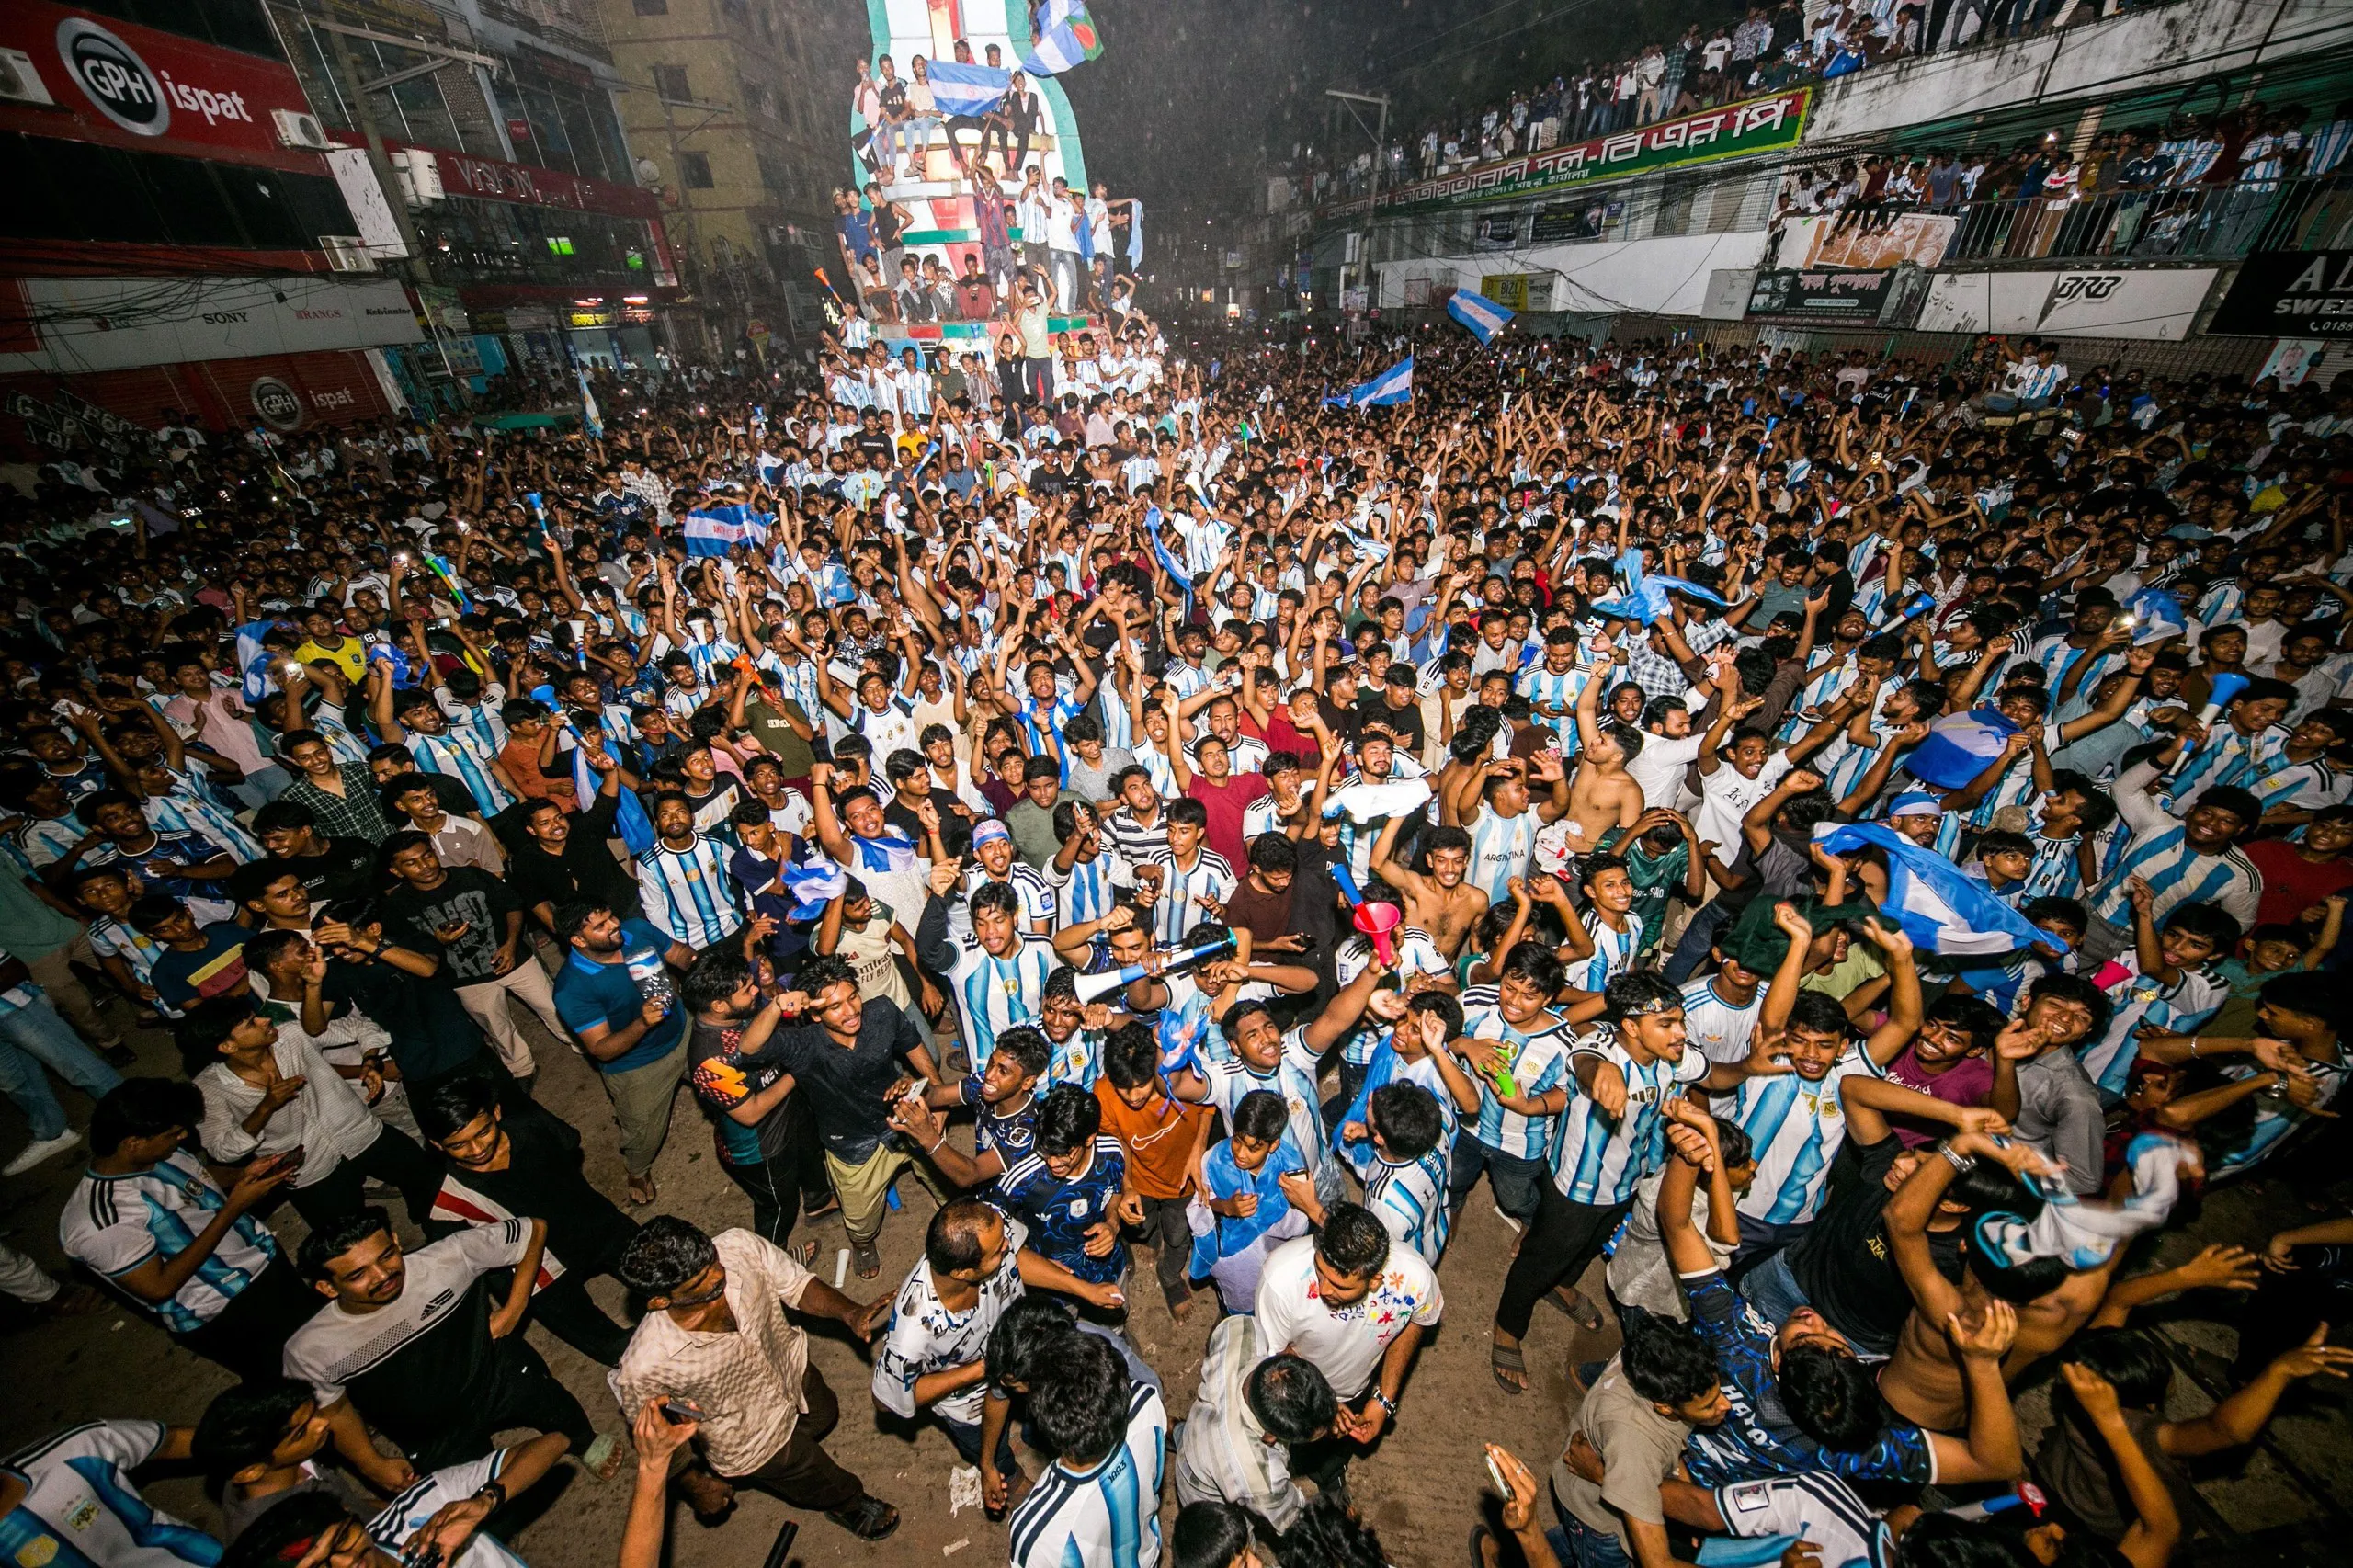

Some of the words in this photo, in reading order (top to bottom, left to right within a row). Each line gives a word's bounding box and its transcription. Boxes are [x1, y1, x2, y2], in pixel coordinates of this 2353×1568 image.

[83, 58, 153, 104] GPH
[160, 70, 254, 126] ispat
[449, 157, 537, 198] VISION
[1327, 190, 1389, 221] বাংলাশ
[2058, 275, 2122, 299] BRB
[202, 312, 249, 324] SONY
[303, 310, 343, 320] RANGS
[366, 308, 412, 316] Kelvinator
[262, 393, 296, 415] GPH
[309, 386, 356, 410] ispat
